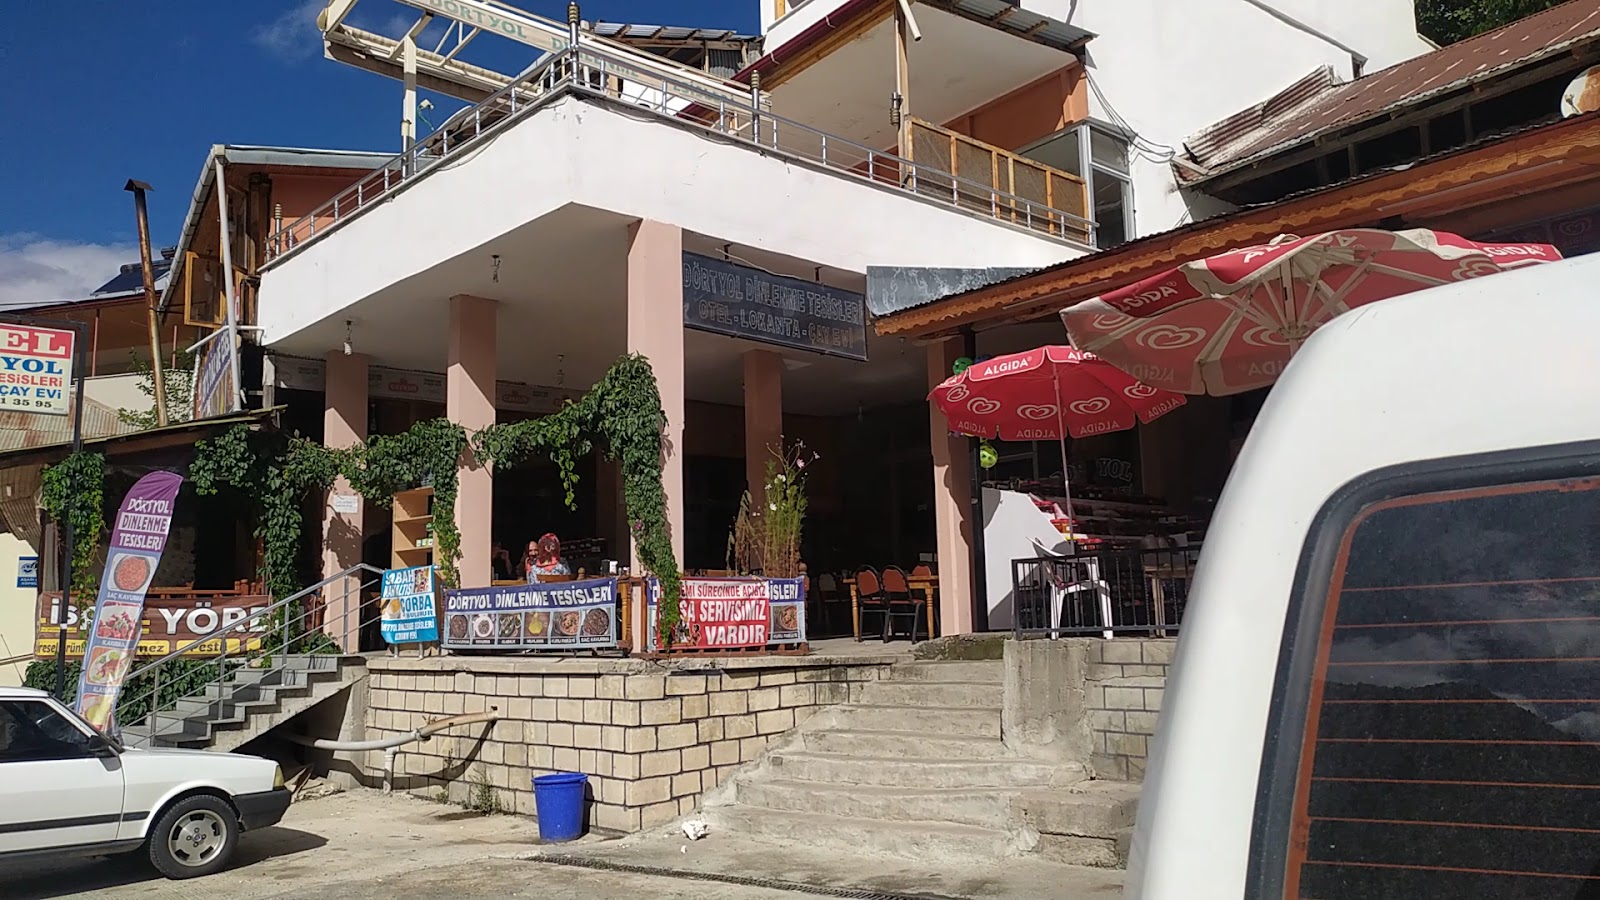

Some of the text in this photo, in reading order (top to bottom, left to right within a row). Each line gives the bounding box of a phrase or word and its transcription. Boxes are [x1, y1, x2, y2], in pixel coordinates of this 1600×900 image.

[684, 261, 744, 300] DÖRTYOL
[699, 299, 733, 325] OTEL
[740, 308, 801, 339] LOKANTA
[0, 356, 63, 374] YOL
[13, 398, 30, 406] 35
[35, 400, 52, 408] 95
[127, 496, 170, 514] DÖRTYOL
[448, 581, 613, 610] DÖRTYOL DİNLENME TESİSLERİ
[705, 624, 765, 645] VARDIR
